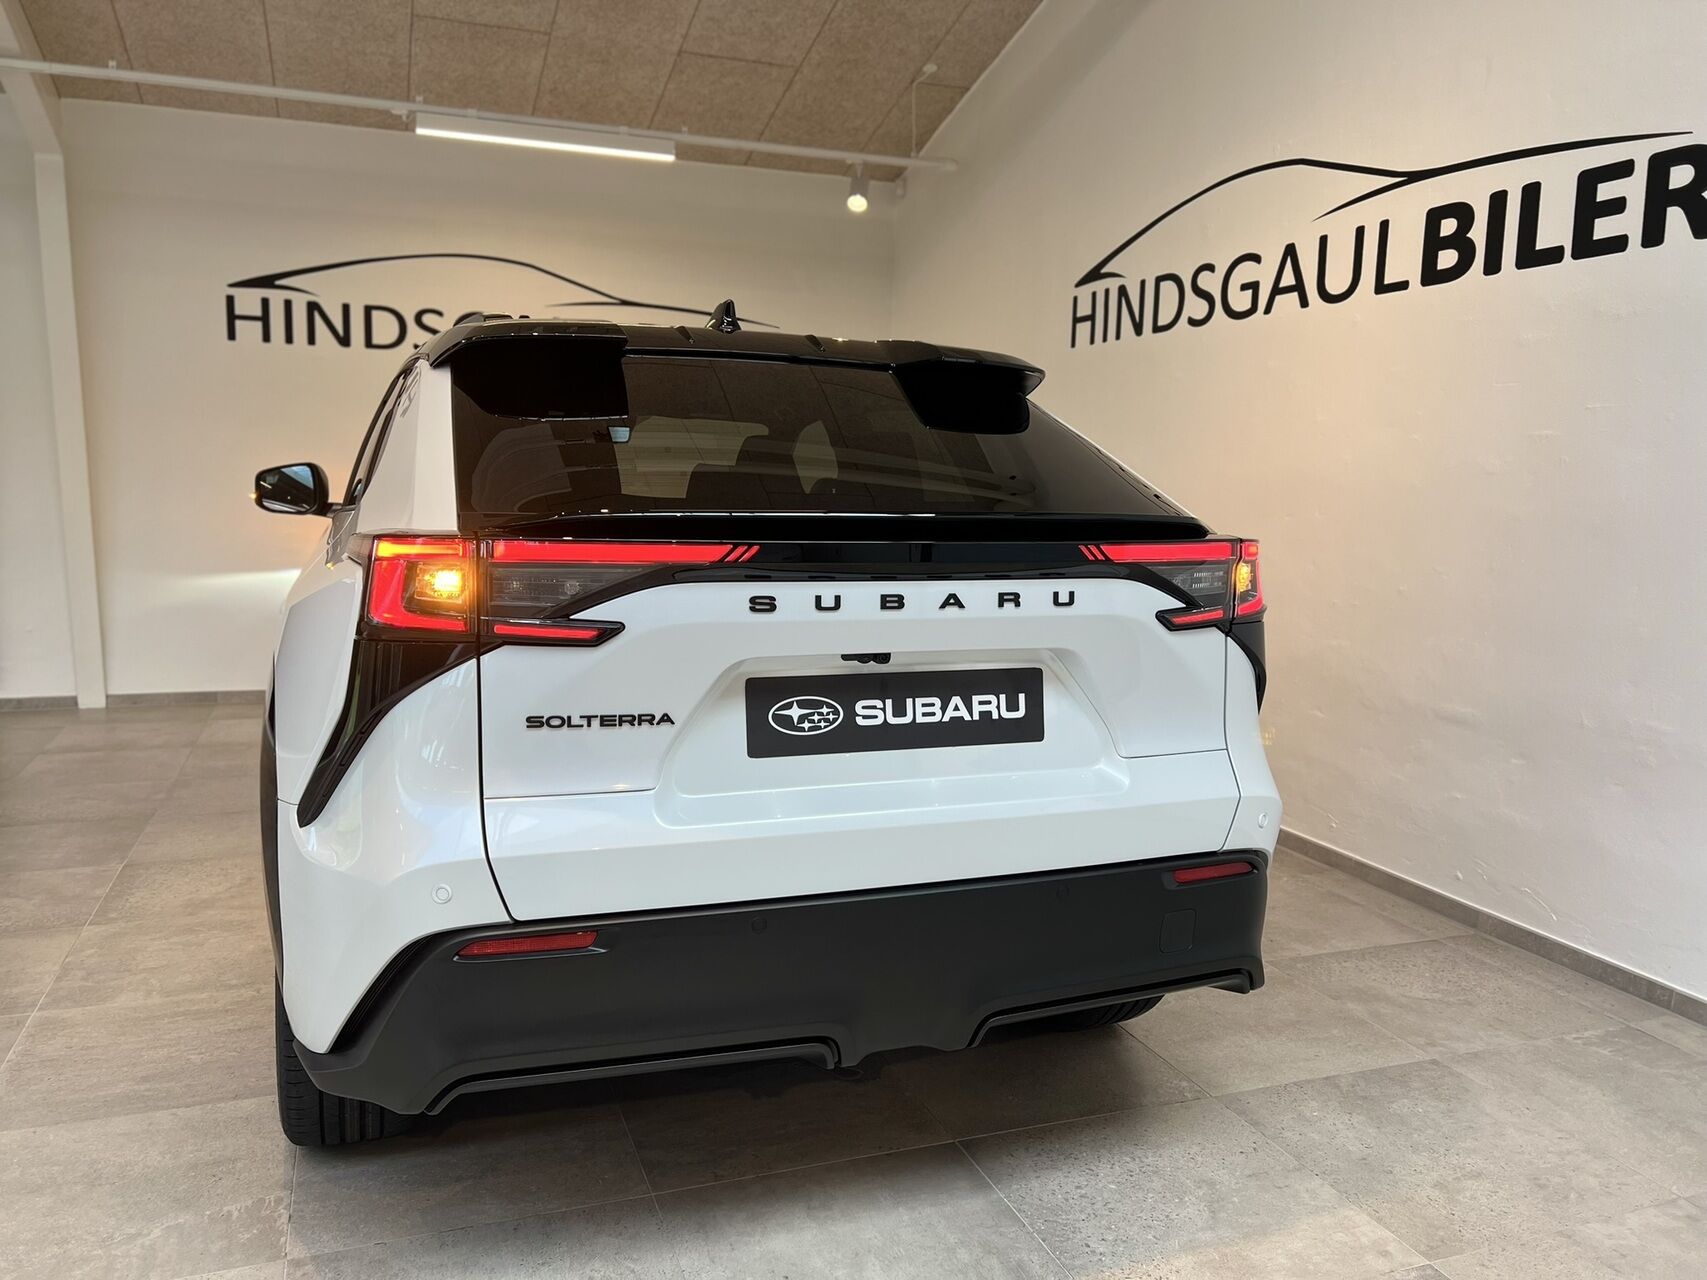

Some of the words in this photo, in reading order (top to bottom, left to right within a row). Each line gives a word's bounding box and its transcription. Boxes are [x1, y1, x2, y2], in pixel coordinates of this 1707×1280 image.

[225, 294, 483, 350] HINDS
[748, 590, 1076, 613] SUBARU
[525, 712, 676, 729] SOLTERRA
[854, 692, 1027, 727] SUBARU
